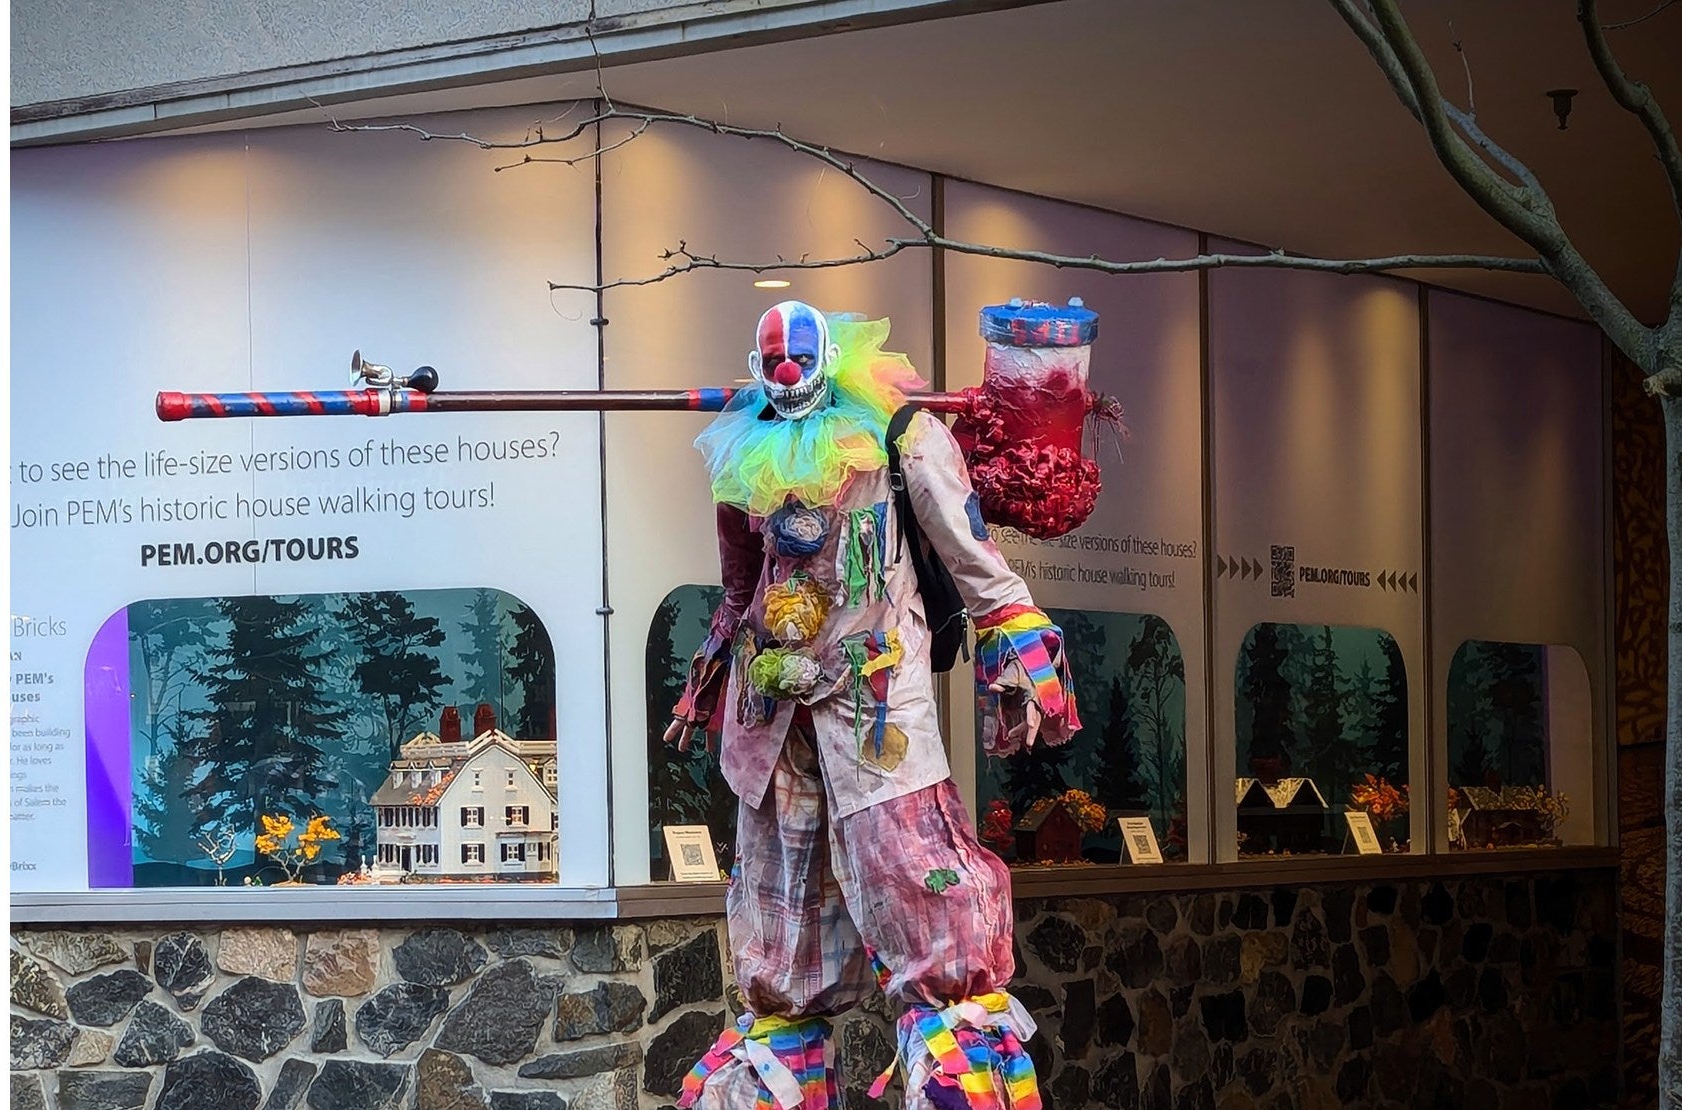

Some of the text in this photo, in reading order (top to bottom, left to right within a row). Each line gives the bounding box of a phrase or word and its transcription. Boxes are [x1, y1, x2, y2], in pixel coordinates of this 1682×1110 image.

[19, 430, 560, 483] to see the life-size versions of these houses?
[11, 481, 495, 529] Join PEM's historic house walking tours!
[141, 536, 359, 567] PEM.ORG/TOURS
[1079, 533, 1119, 553] versions
[1121, 534, 1131, 554] of
[1133, 536, 1158, 556] these
[1161, 538, 1197, 558] houses?
[1039, 560, 1075, 582] historic
[1078, 563, 1108, 584] house
[1109, 566, 1147, 591] walking
[1149, 571, 1176, 588] tours!
[1299, 566, 1371, 587] PEM.ORG/TOURS
[13, 615, 67, 637] Bricks
[16, 672, 54, 685] PEM's
[35, 727, 71, 739] building
[34, 742, 53, 753] long
[29, 755, 52, 765] loves
